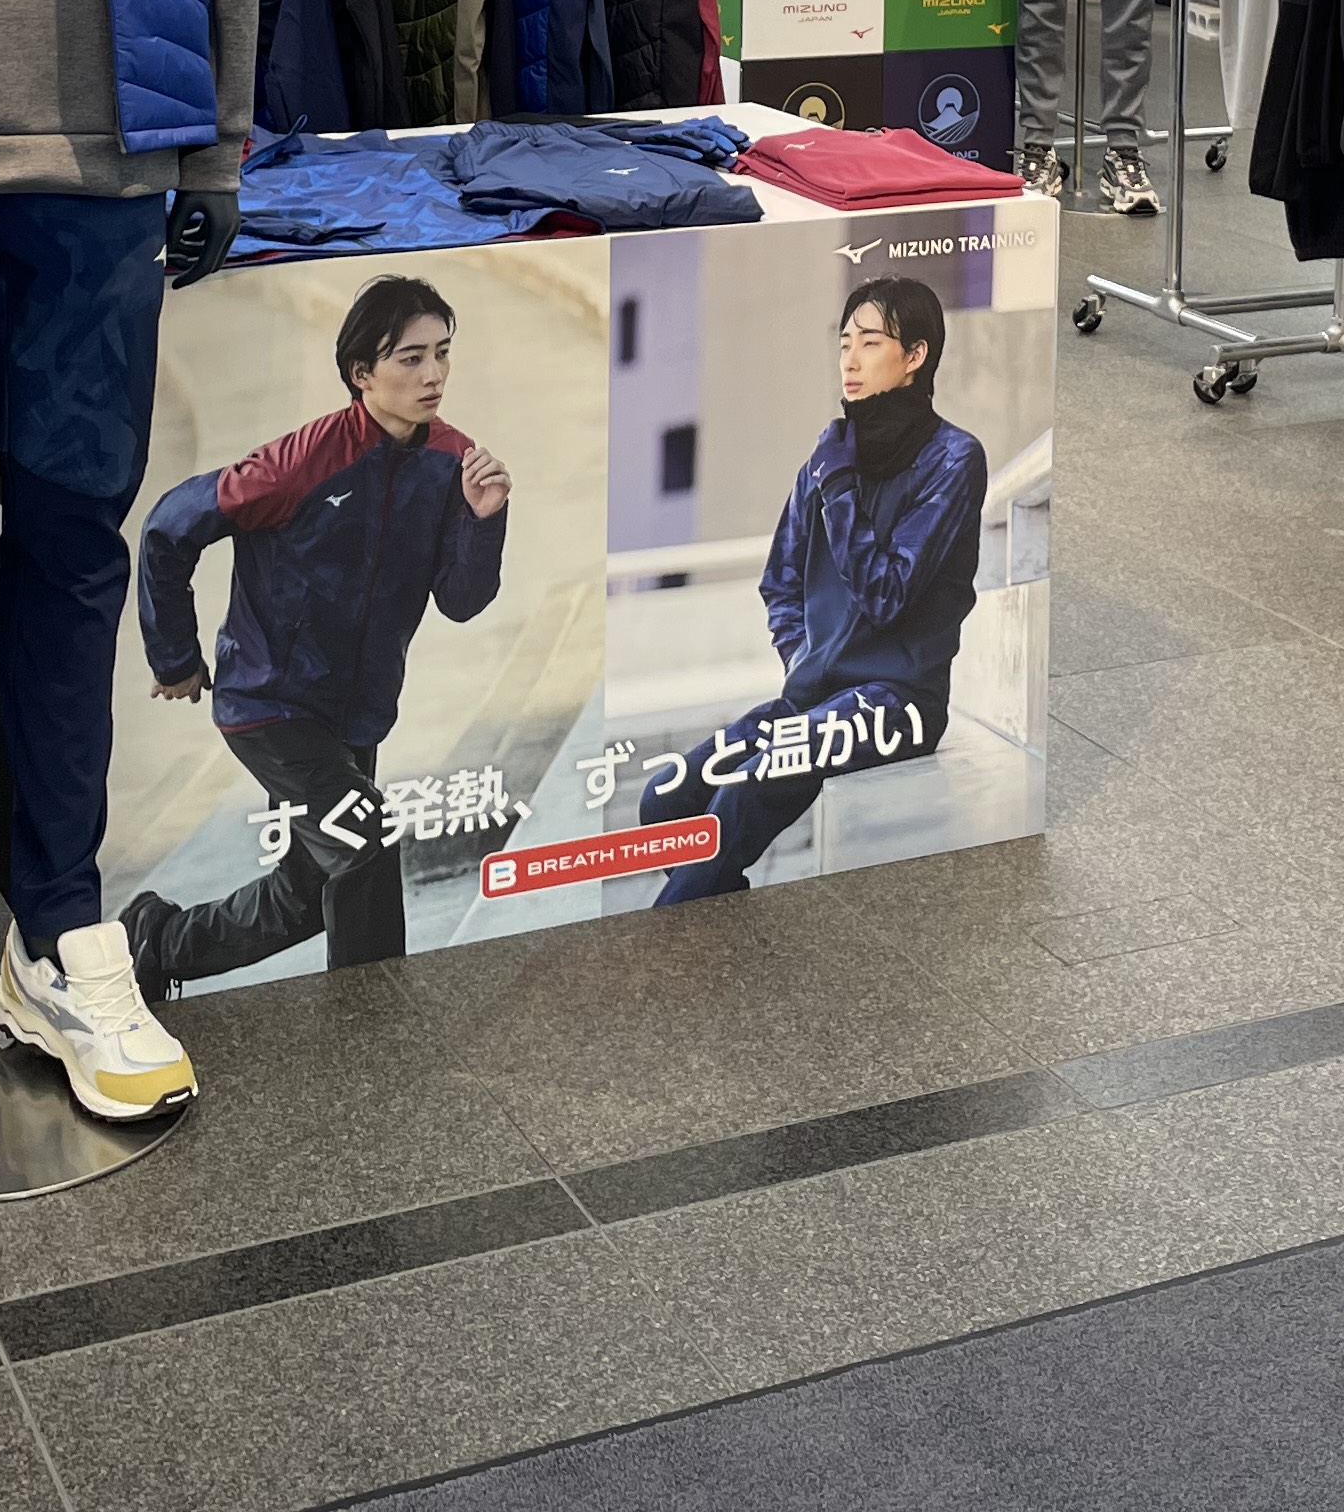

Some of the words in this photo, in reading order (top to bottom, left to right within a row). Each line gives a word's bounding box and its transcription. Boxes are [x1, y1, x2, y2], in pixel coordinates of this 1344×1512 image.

[782, 2, 847, 15] MIZUNO
[798, 15, 833, 23] JAPAN
[937, 8, 971, 16] JAPAN
[888, 238, 954, 259] MIZUNO
[958, 230, 1036, 252] TRAINING
[247, 764, 533, 867] すぐ発熱、
[575, 702, 924, 810] ずっと温かい
[527, 847, 615, 877] BREATH
[619, 830, 711, 859] THERMO
